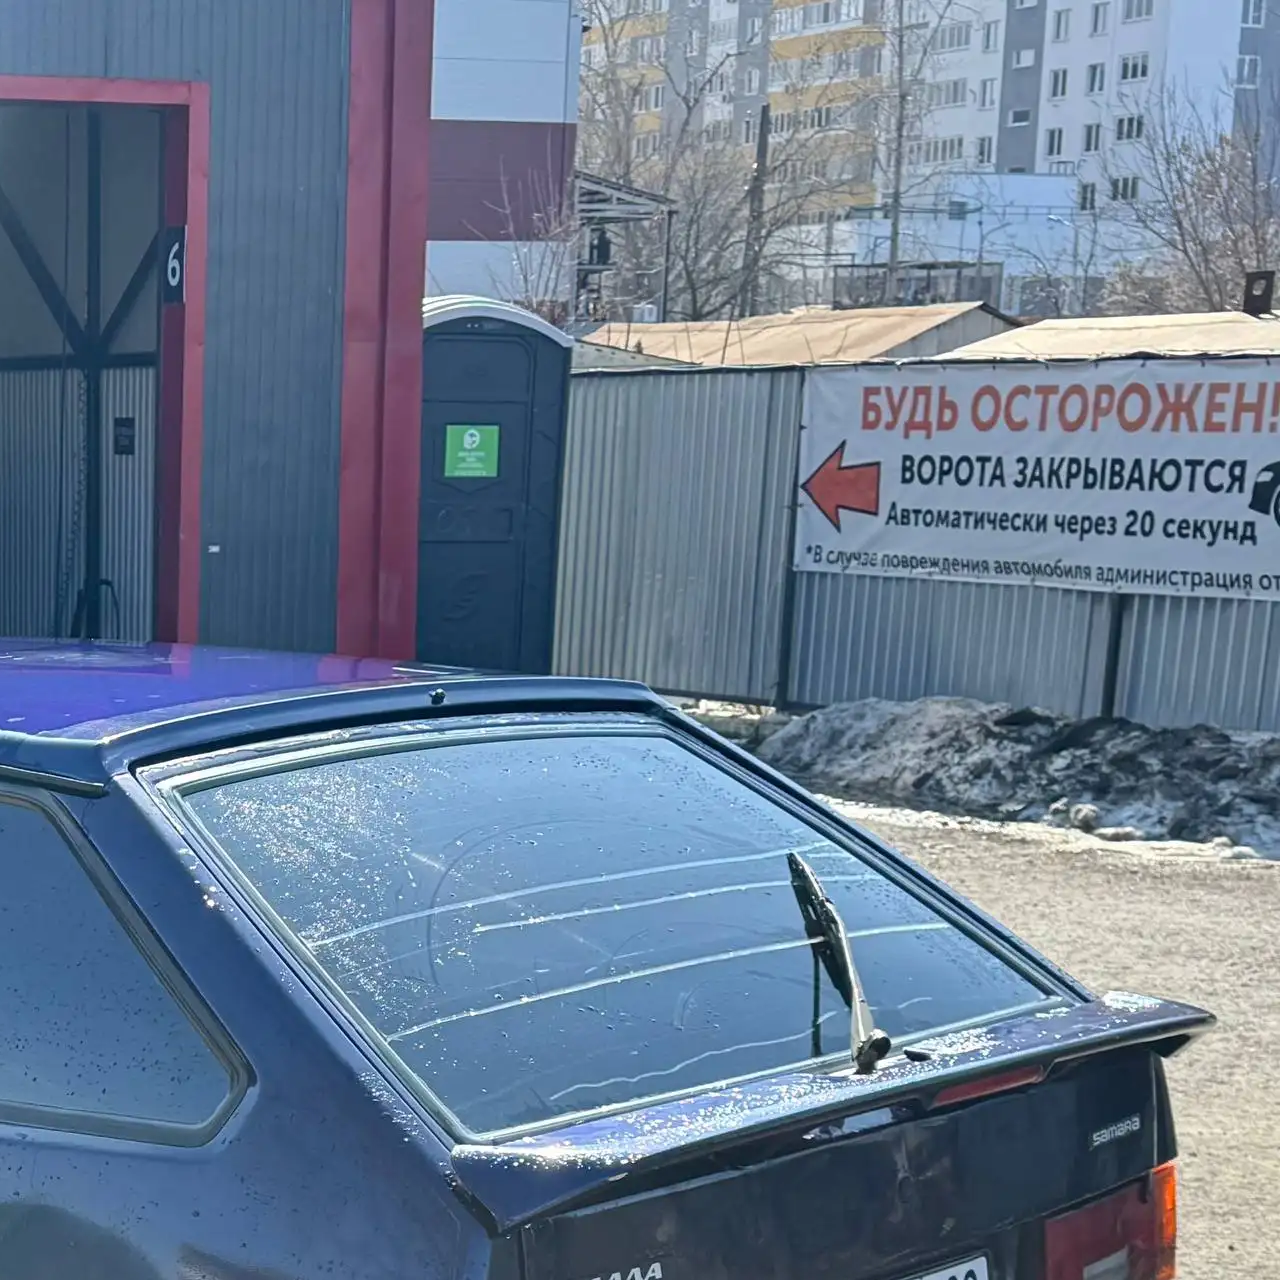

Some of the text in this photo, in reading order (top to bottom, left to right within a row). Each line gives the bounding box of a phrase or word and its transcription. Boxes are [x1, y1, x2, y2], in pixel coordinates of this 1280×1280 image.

[167, 242, 180, 287] 6
[861, 382, 1280, 440] БУДЬ ОСТОРОЖЕН!
[900, 454, 1248, 494] ВОРОТА ЗАКРЫВАЮТСЯ
[885, 501, 1258, 547] Автоматически через 20 секунд
[880, 553, 990, 576] повреждения
[993, 558, 1092, 580] автомобиля
[1096, 565, 1253, 592] администрация
